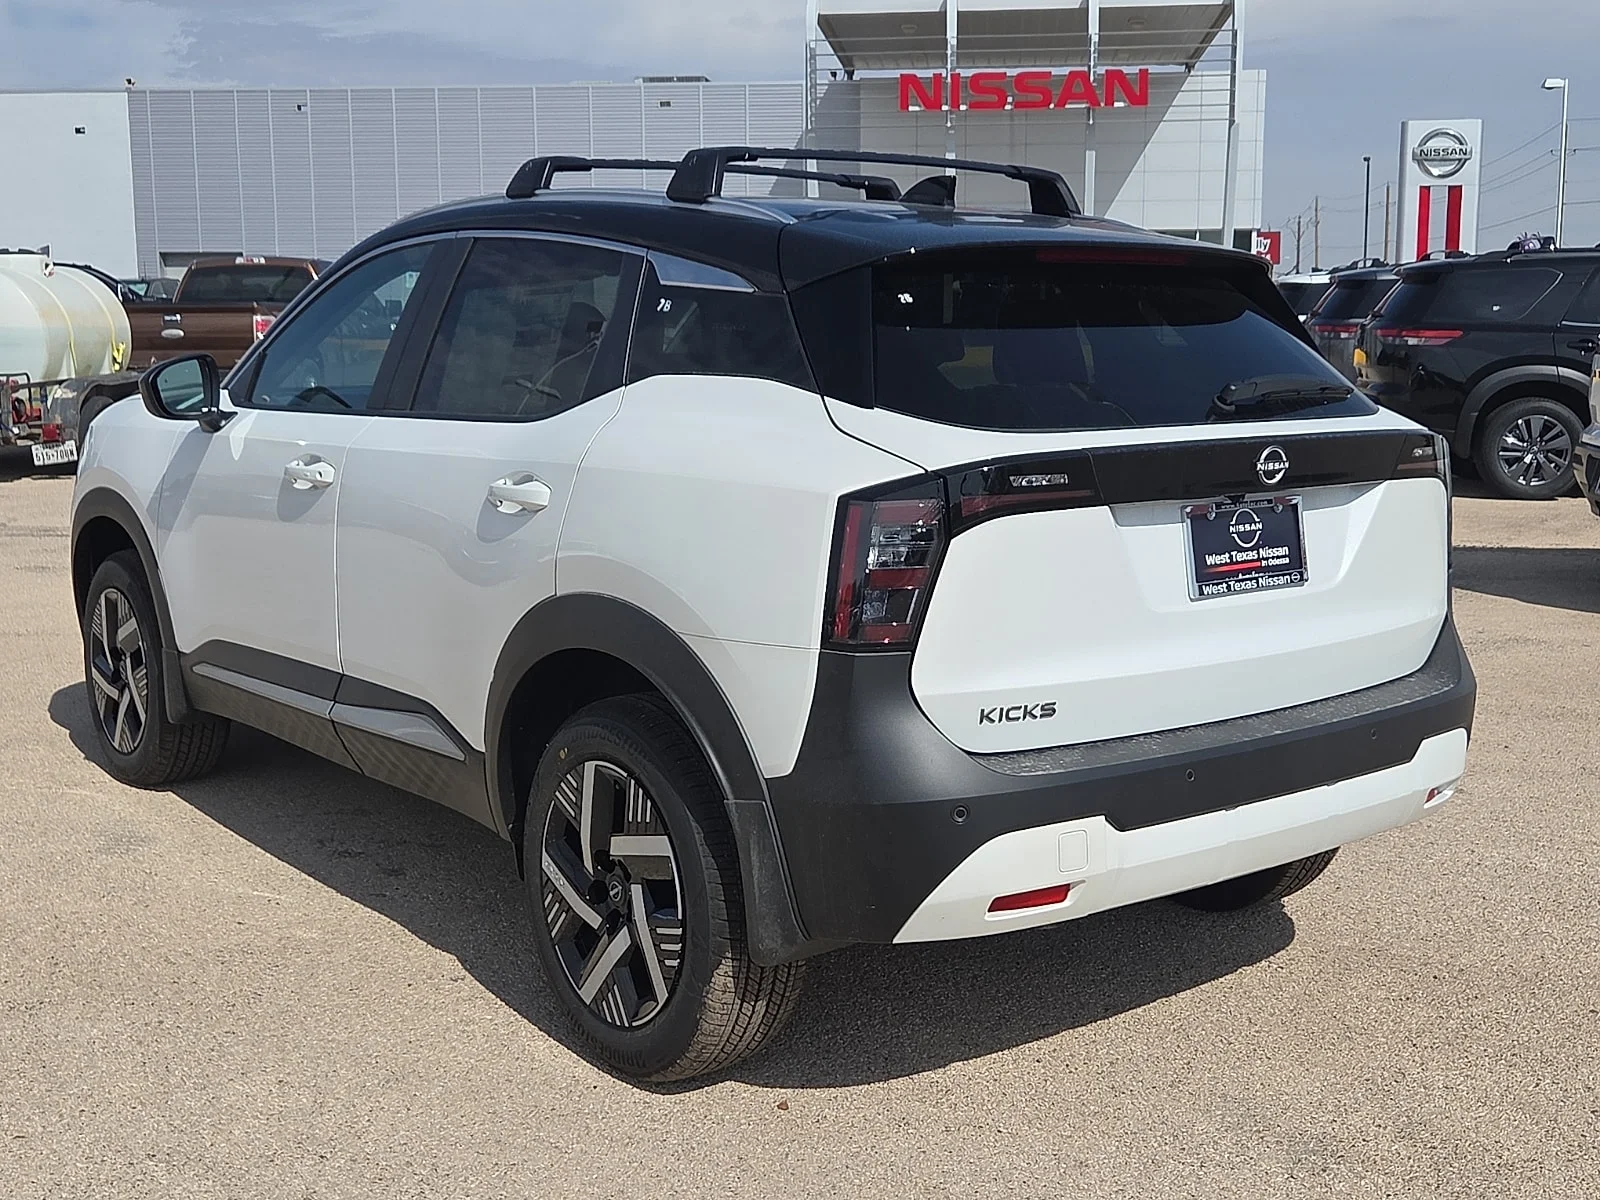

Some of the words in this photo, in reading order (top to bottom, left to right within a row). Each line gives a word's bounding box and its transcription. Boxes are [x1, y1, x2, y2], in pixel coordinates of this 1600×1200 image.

[899, 68, 1149, 111] NISSAN
[1419, 147, 1468, 157] NISSAN
[1256, 461, 1290, 471] NISSAN
[1229, 522, 1263, 533] NISSAN
[1205, 552, 1230, 566] West
[1230, 549, 1258, 562] Texas
[1259, 545, 1289, 559] Nissan
[1202, 583, 1228, 595] West
[1228, 579, 1258, 592] Texas
[1258, 575, 1291, 588] Nissan
[979, 701, 1057, 725] KICKS
